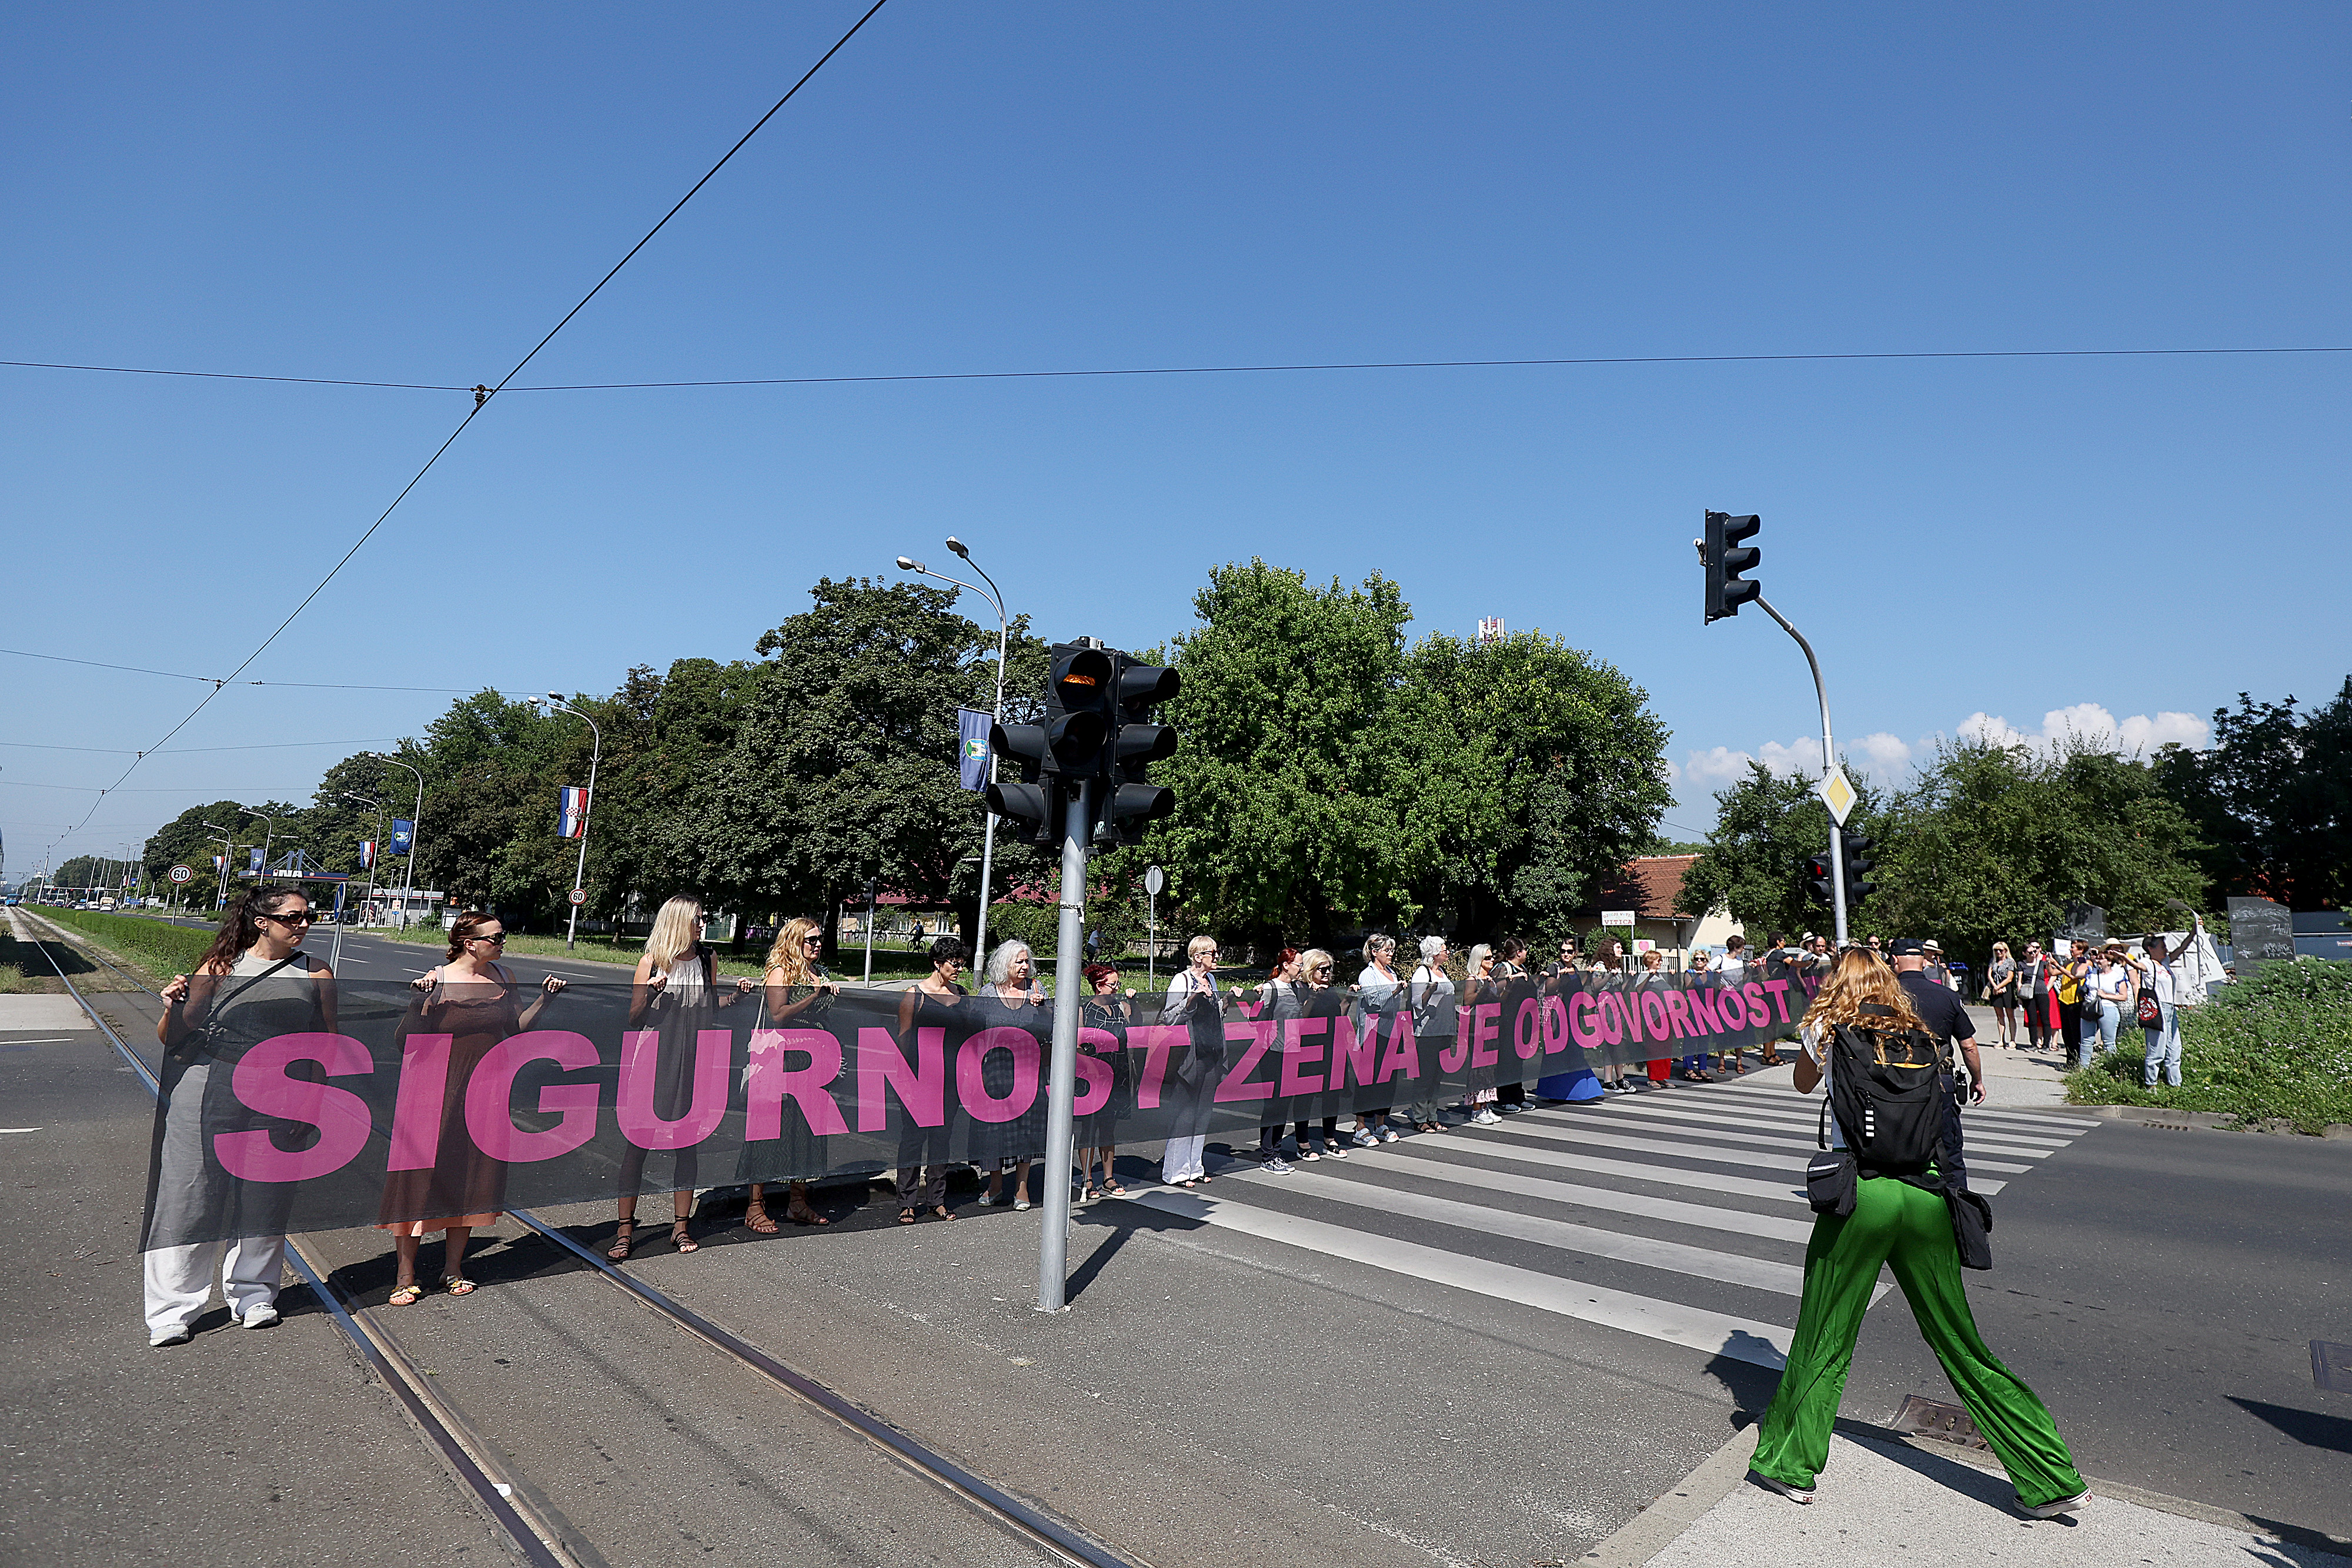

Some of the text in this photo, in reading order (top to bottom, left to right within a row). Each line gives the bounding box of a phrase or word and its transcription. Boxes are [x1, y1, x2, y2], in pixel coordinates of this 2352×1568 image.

[173, 870, 188, 879] 60
[273, 869, 303, 878] INA
[573, 892, 583, 901] 60
[213, 979, 1791, 1183] SIGURNOST ŽENA JE ODGOVORNOST
